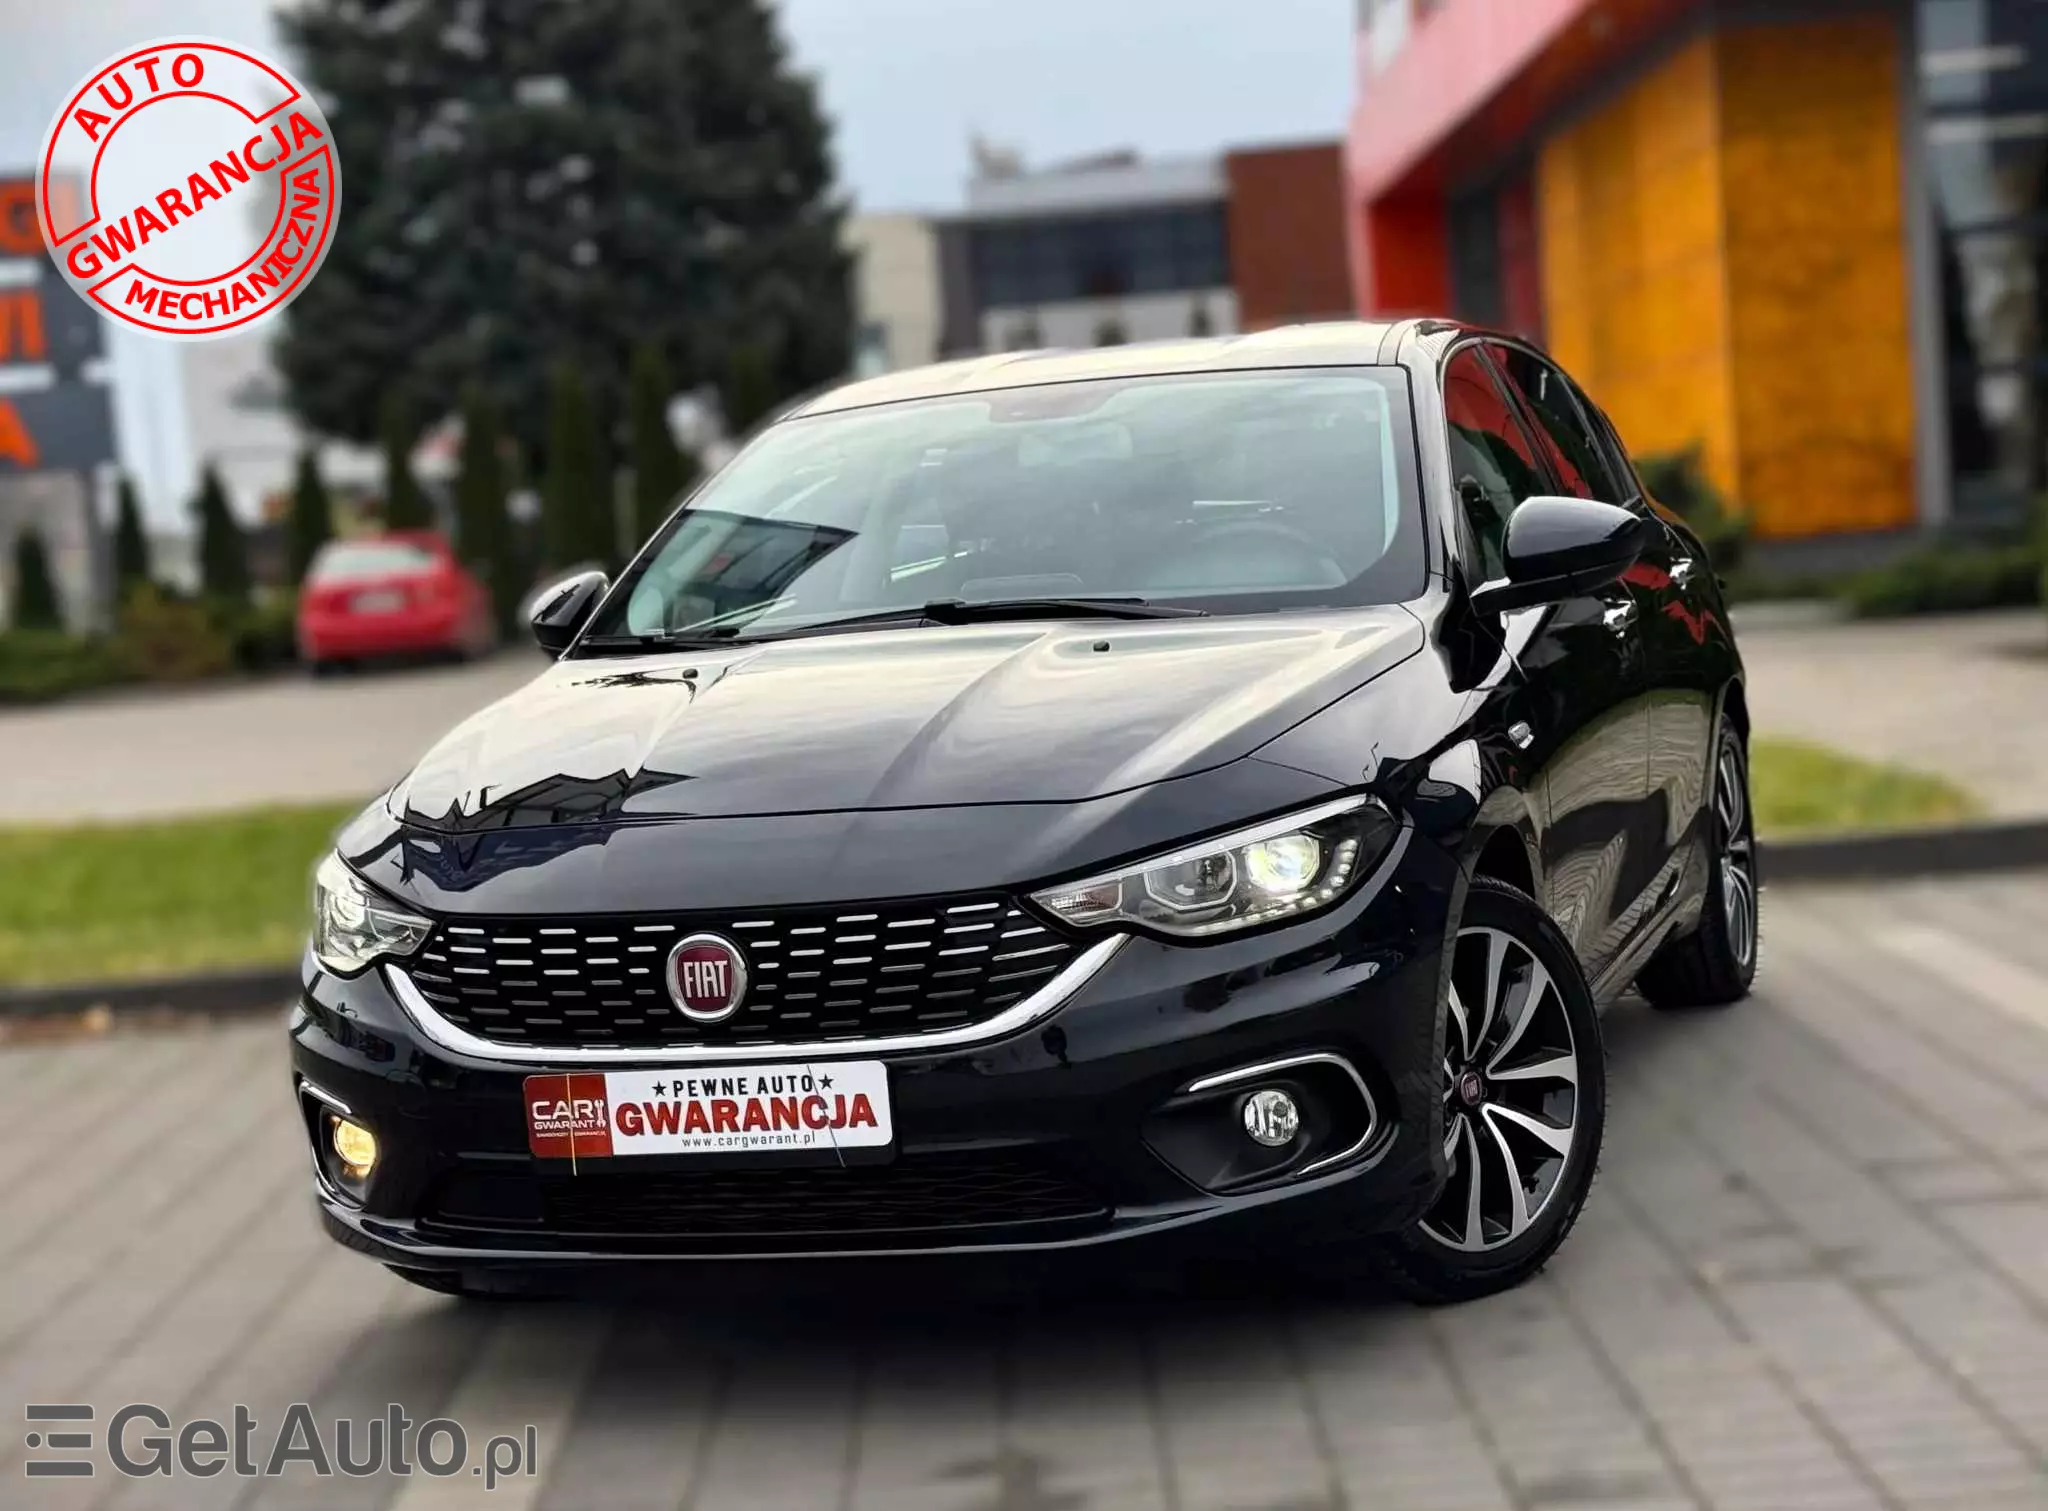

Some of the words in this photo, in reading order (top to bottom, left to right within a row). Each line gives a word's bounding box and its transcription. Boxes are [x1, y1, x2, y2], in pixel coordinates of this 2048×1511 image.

[683, 960, 728, 998] FIAT
[672, 1077, 749, 1098] PEWNE
[756, 1074, 815, 1095] AUTO
[532, 1099, 594, 1120] CAR
[615, 1093, 879, 1136] GWARANCJA
[534, 1119, 596, 1130] GWARANT
[681, 1129, 816, 1149] www.cargwarant.pl
